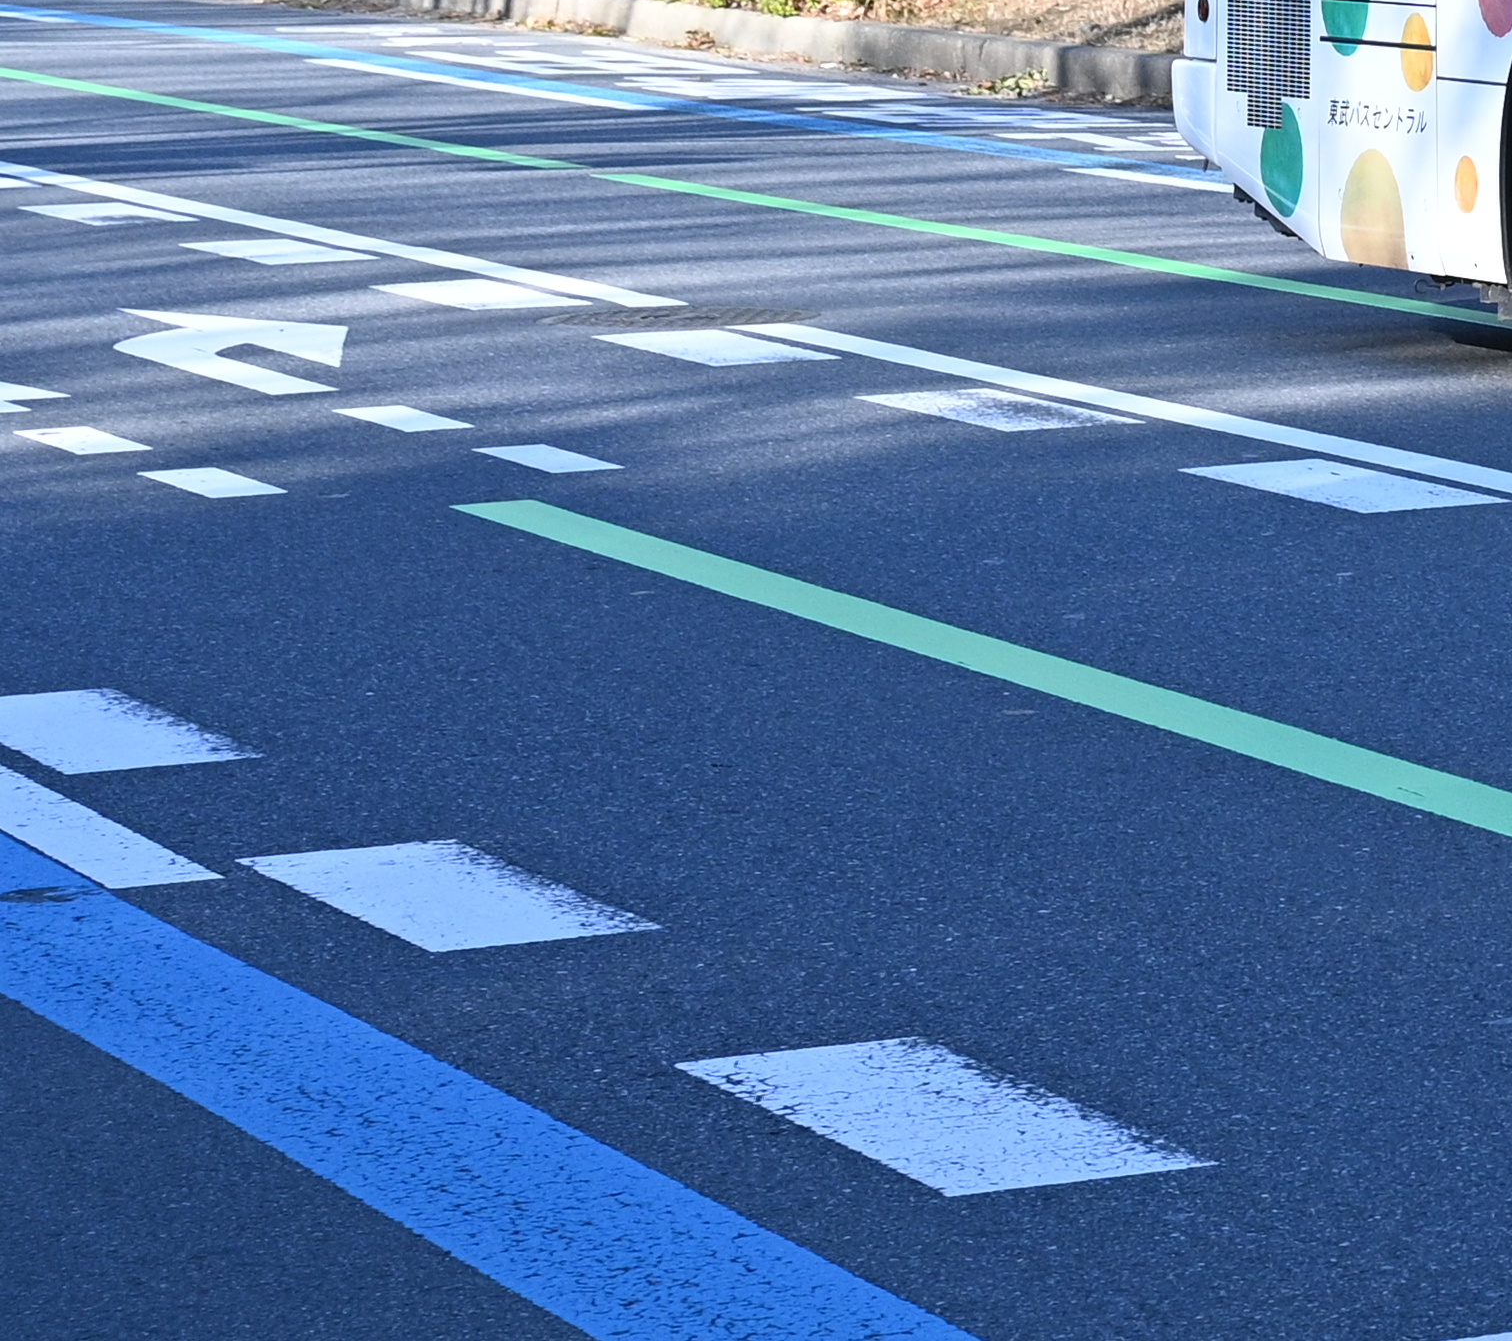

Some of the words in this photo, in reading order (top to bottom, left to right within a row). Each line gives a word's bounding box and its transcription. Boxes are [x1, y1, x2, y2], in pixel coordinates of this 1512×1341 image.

[1327, 99, 1428, 134] 東武バスセントラル
